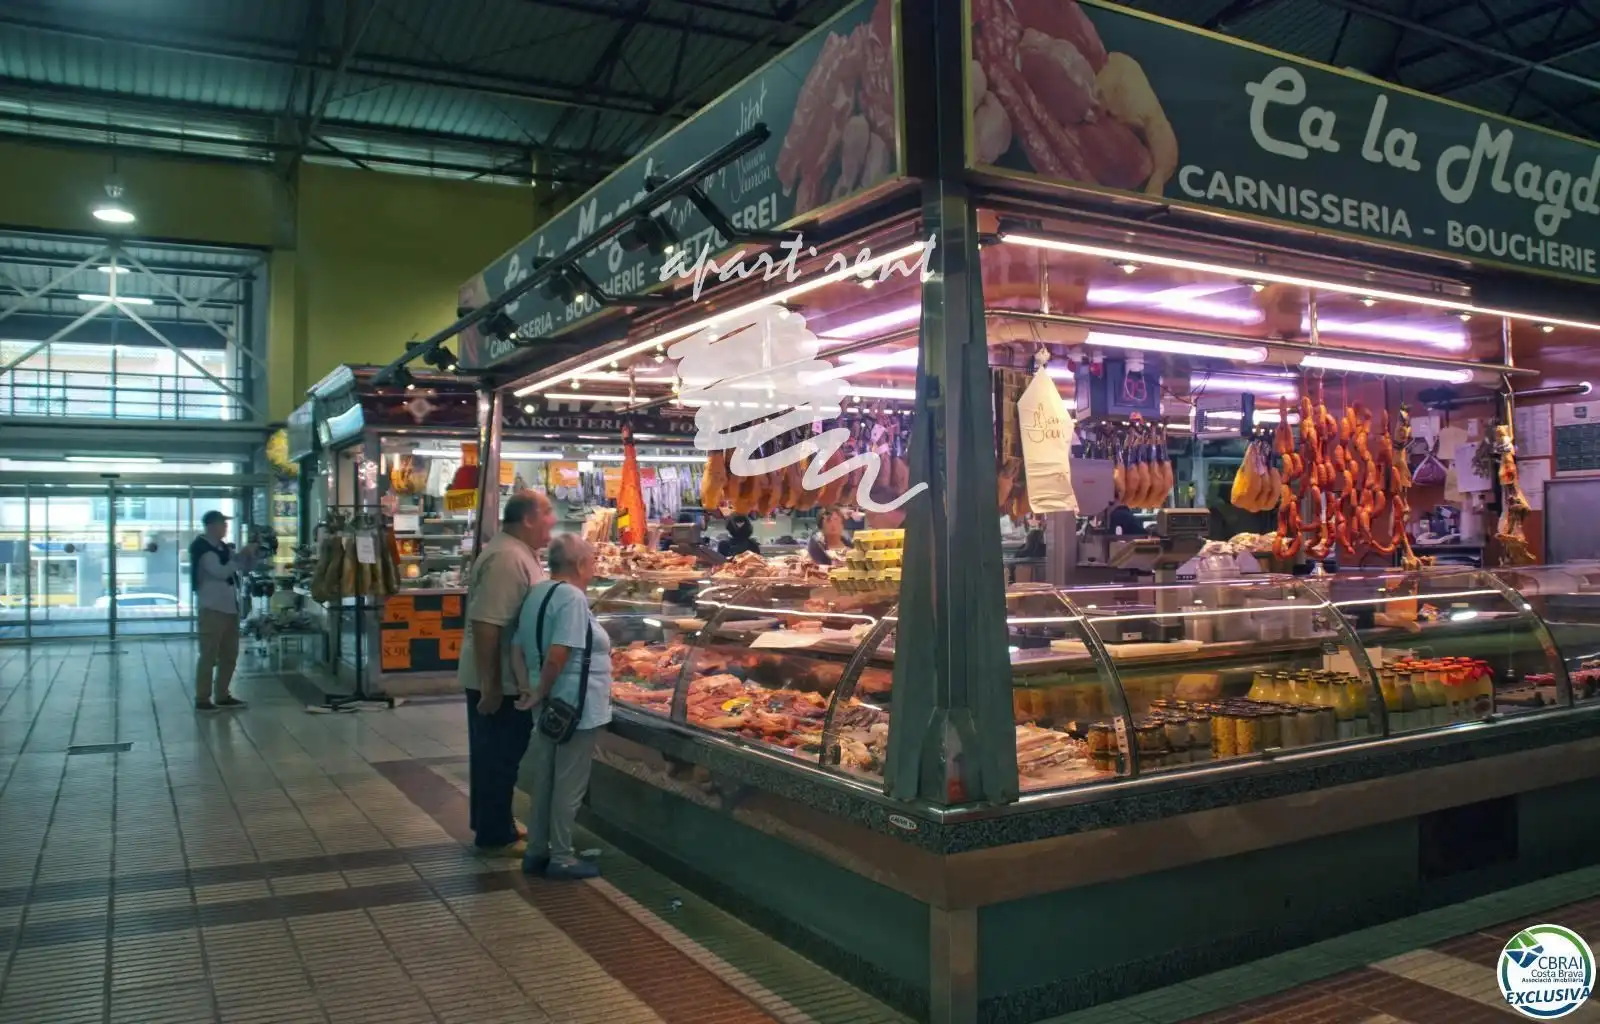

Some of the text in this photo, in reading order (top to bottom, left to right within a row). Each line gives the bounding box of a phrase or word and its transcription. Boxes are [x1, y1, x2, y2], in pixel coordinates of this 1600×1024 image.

[1244, 65, 1341, 160] Ca
[1360, 93, 1421, 171] la
[1178, 164, 1413, 238] CARNISSERIA
[1446, 219, 1597, 274] BOUCHERIE
